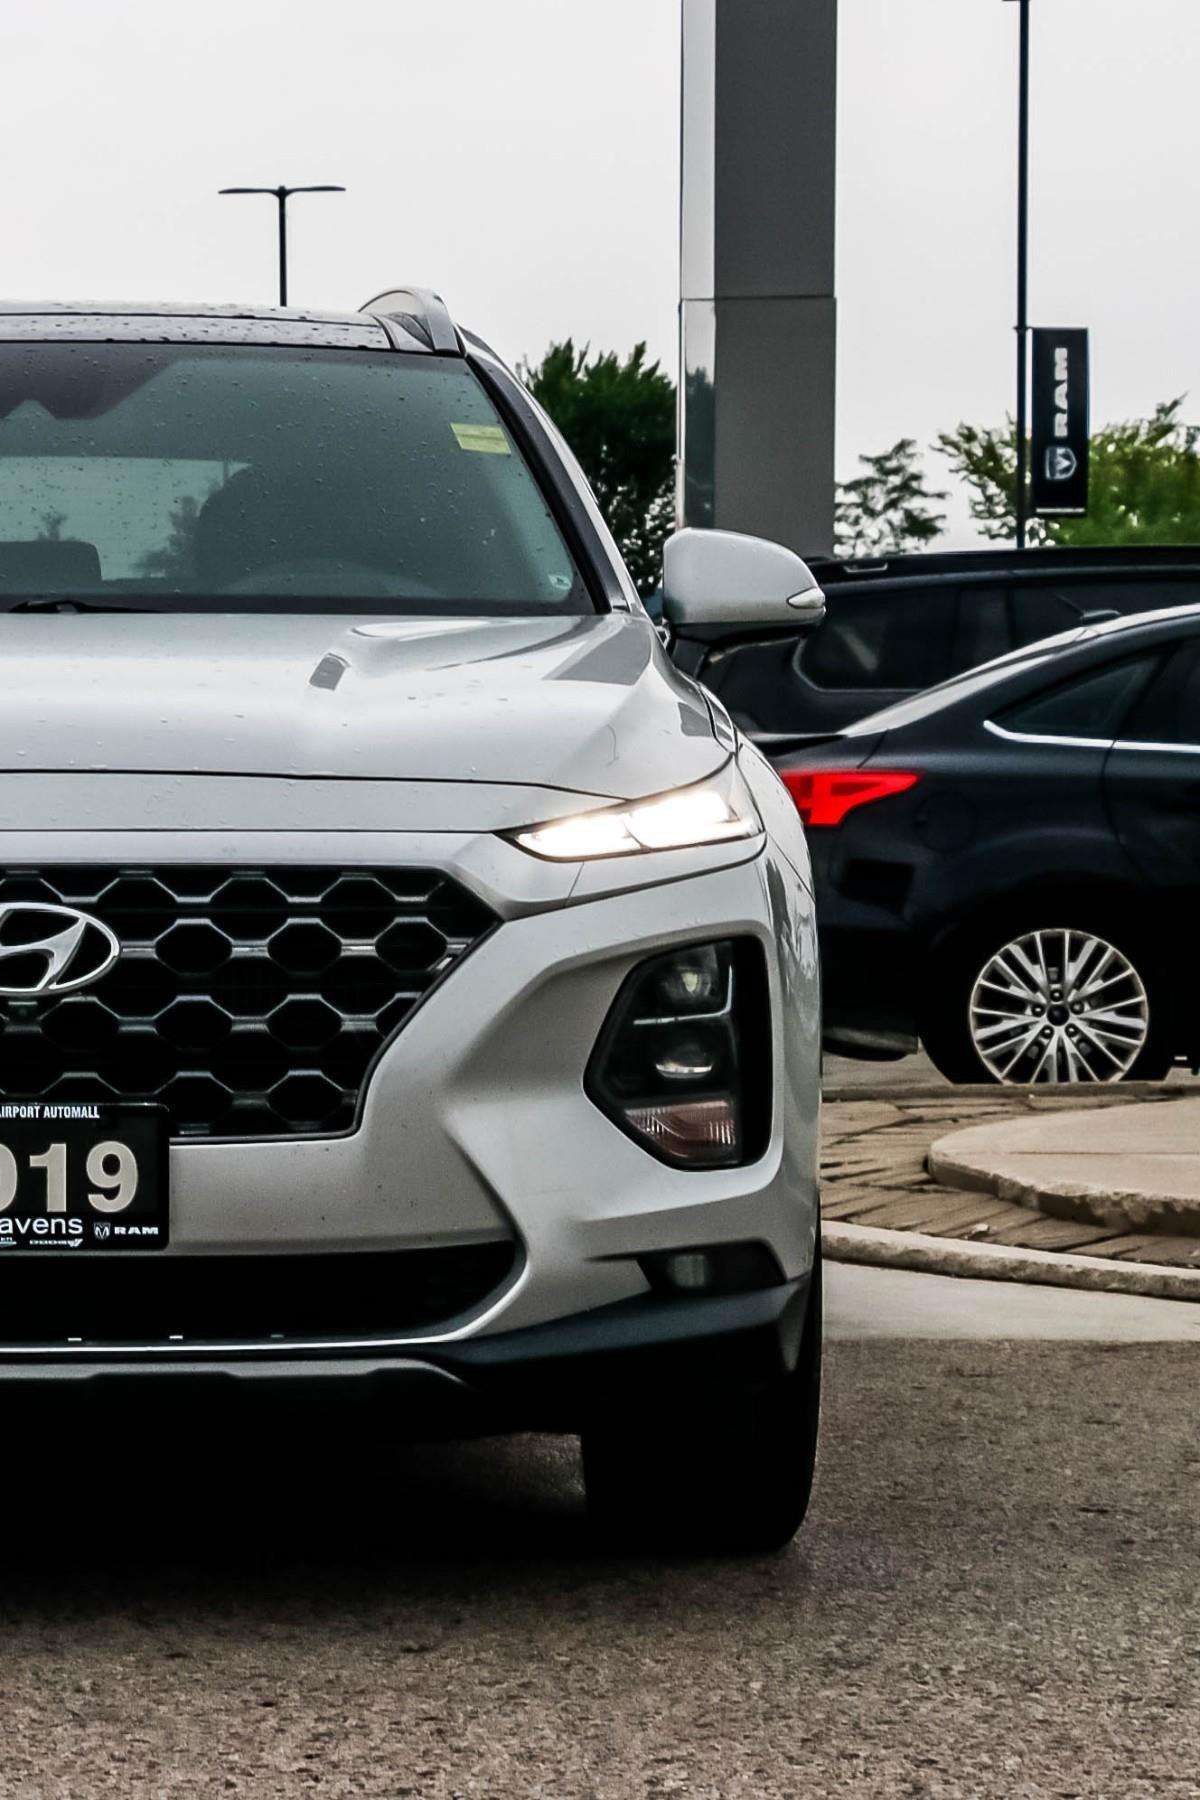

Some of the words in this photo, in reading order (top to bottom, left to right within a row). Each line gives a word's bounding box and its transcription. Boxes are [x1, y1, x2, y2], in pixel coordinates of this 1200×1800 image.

[1054, 347, 1068, 438] RAM
[43, 1105, 100, 1118] AUTOMALL
[114, 1226, 159, 1235] RAM
